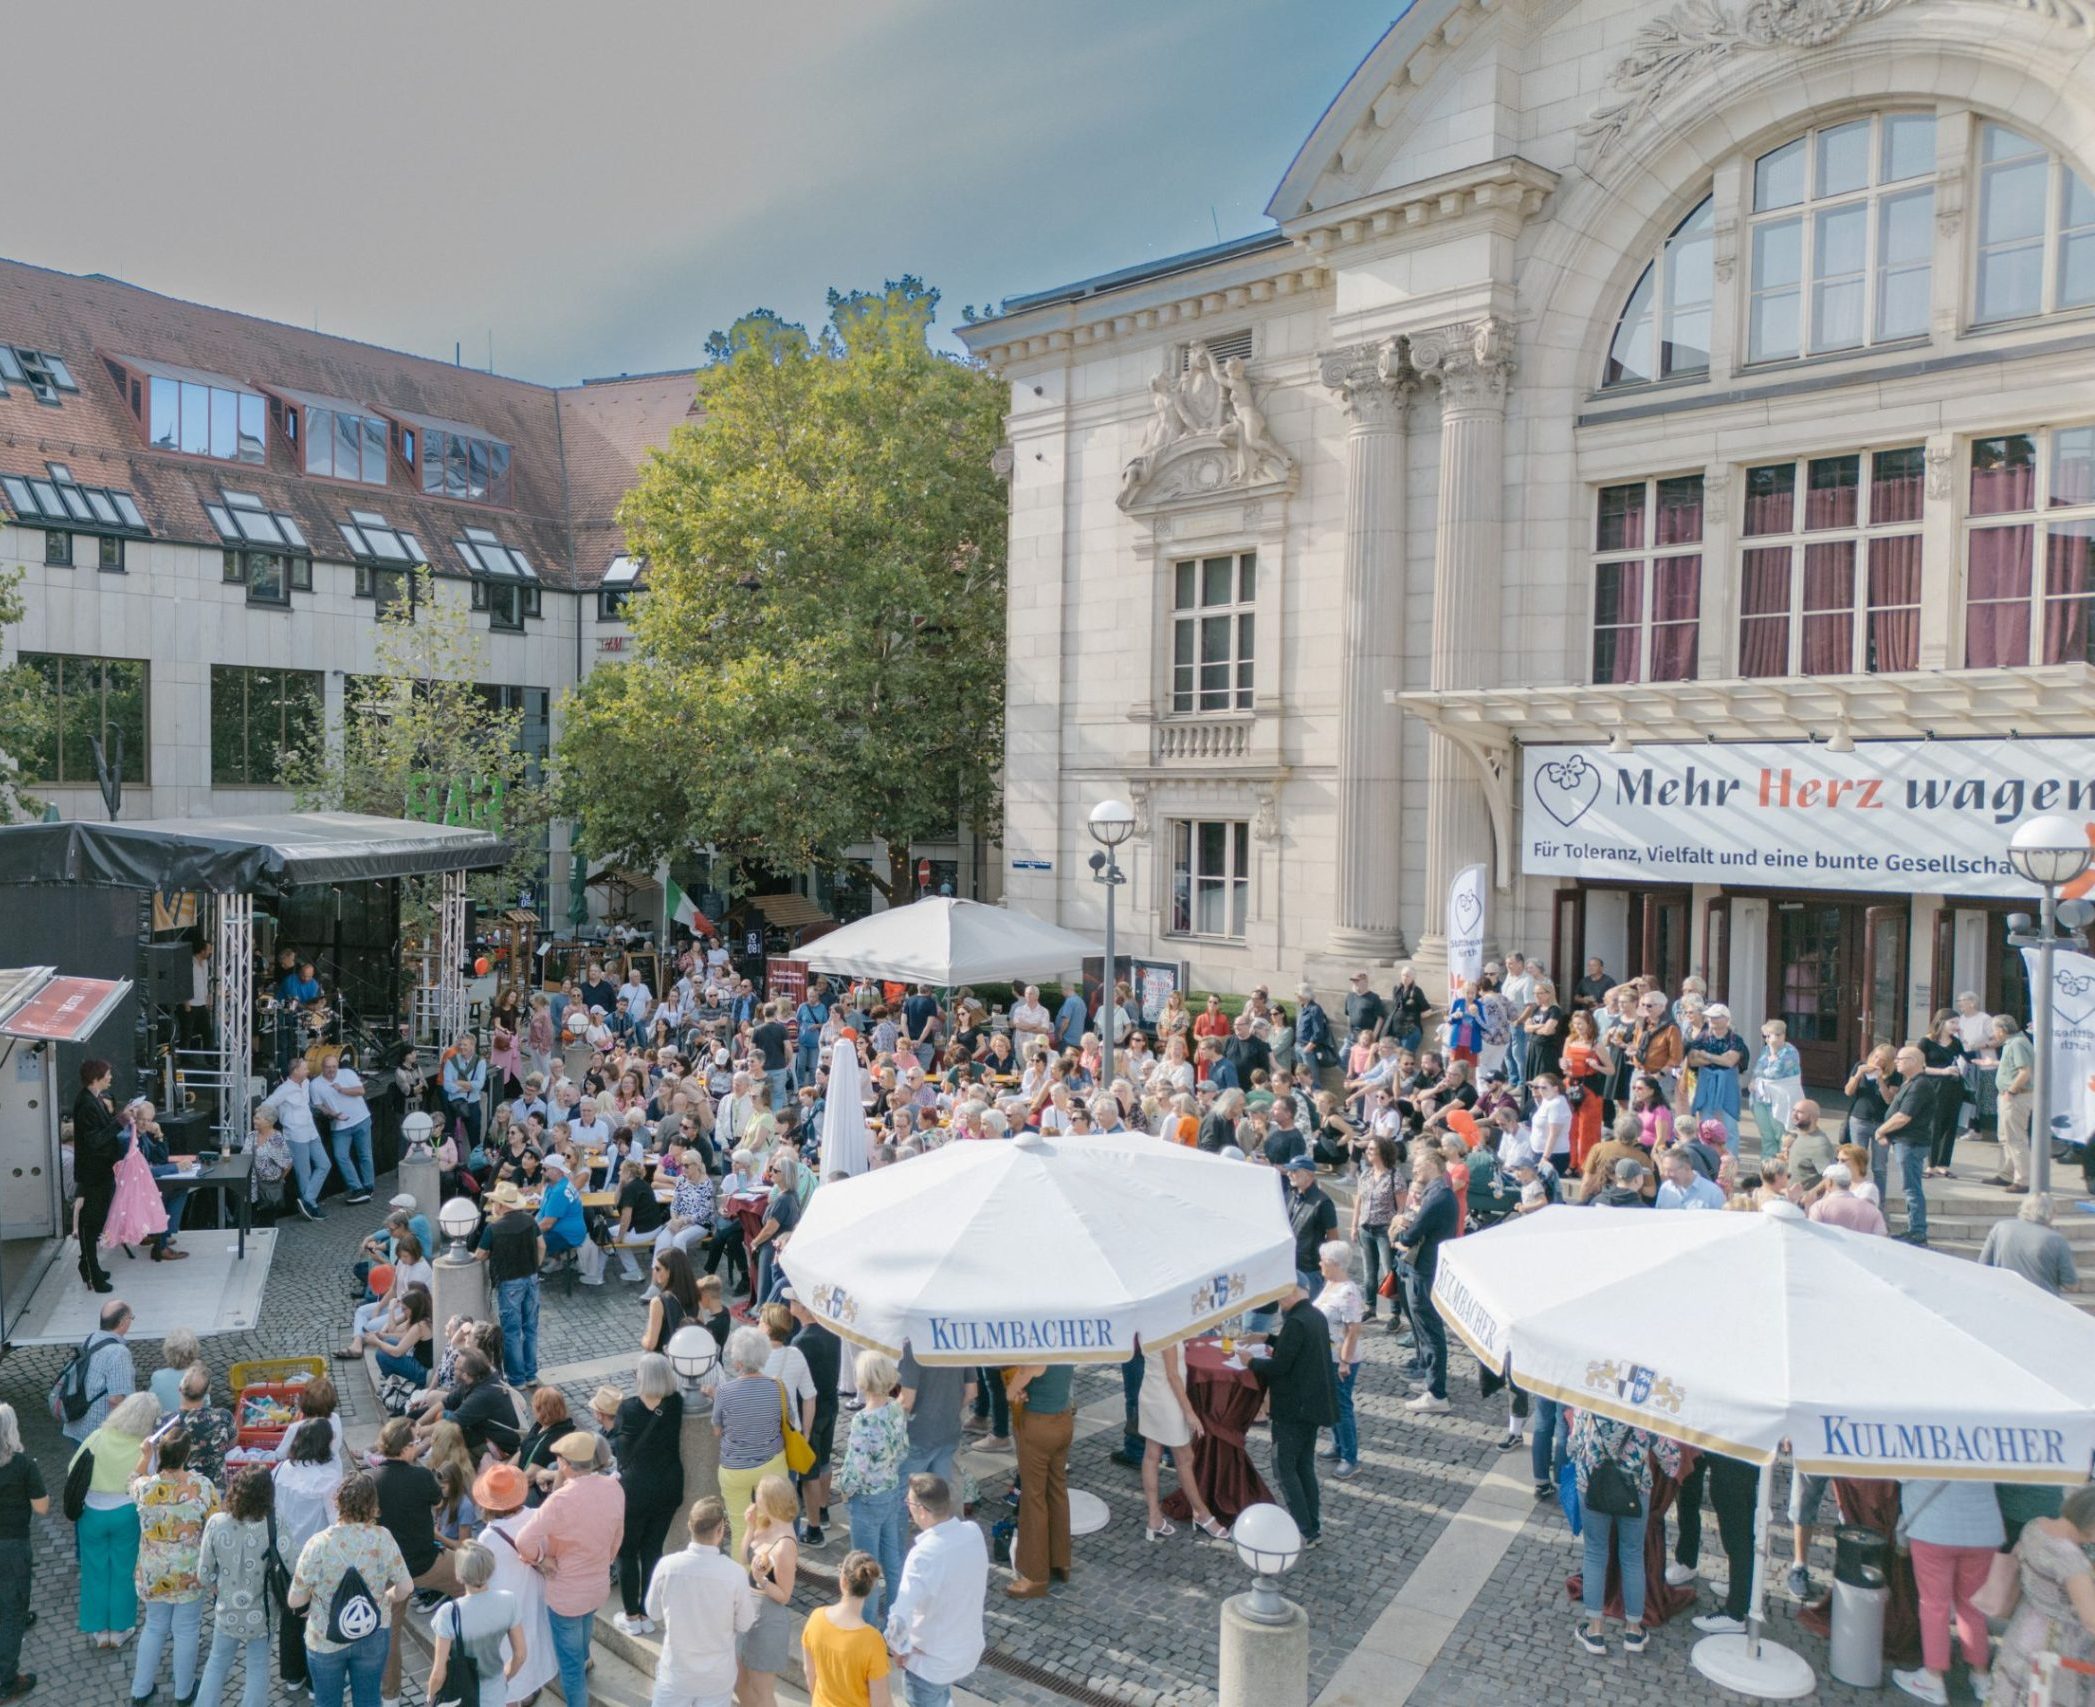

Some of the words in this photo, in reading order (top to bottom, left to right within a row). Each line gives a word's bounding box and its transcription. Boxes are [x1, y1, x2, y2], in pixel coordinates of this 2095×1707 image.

[1616, 766, 1740, 806] Mehr
[1758, 768, 1884, 809] Herz
[1906, 777, 2095, 825] wagen
[1534, 842, 1559, 857] Für
[1563, 843, 1642, 864] Toleranz,
[1646, 846, 1714, 864] Vielfalt
[1720, 849, 1757, 866] und
[1764, 849, 1808, 868] eine
[1815, 851, 1879, 871] bunte
[1885, 853, 2019, 875] Gesellscha
[928, 1316, 1115, 1350] KULMBACHER
[1819, 1415, 2067, 1463] KULMBACHER
